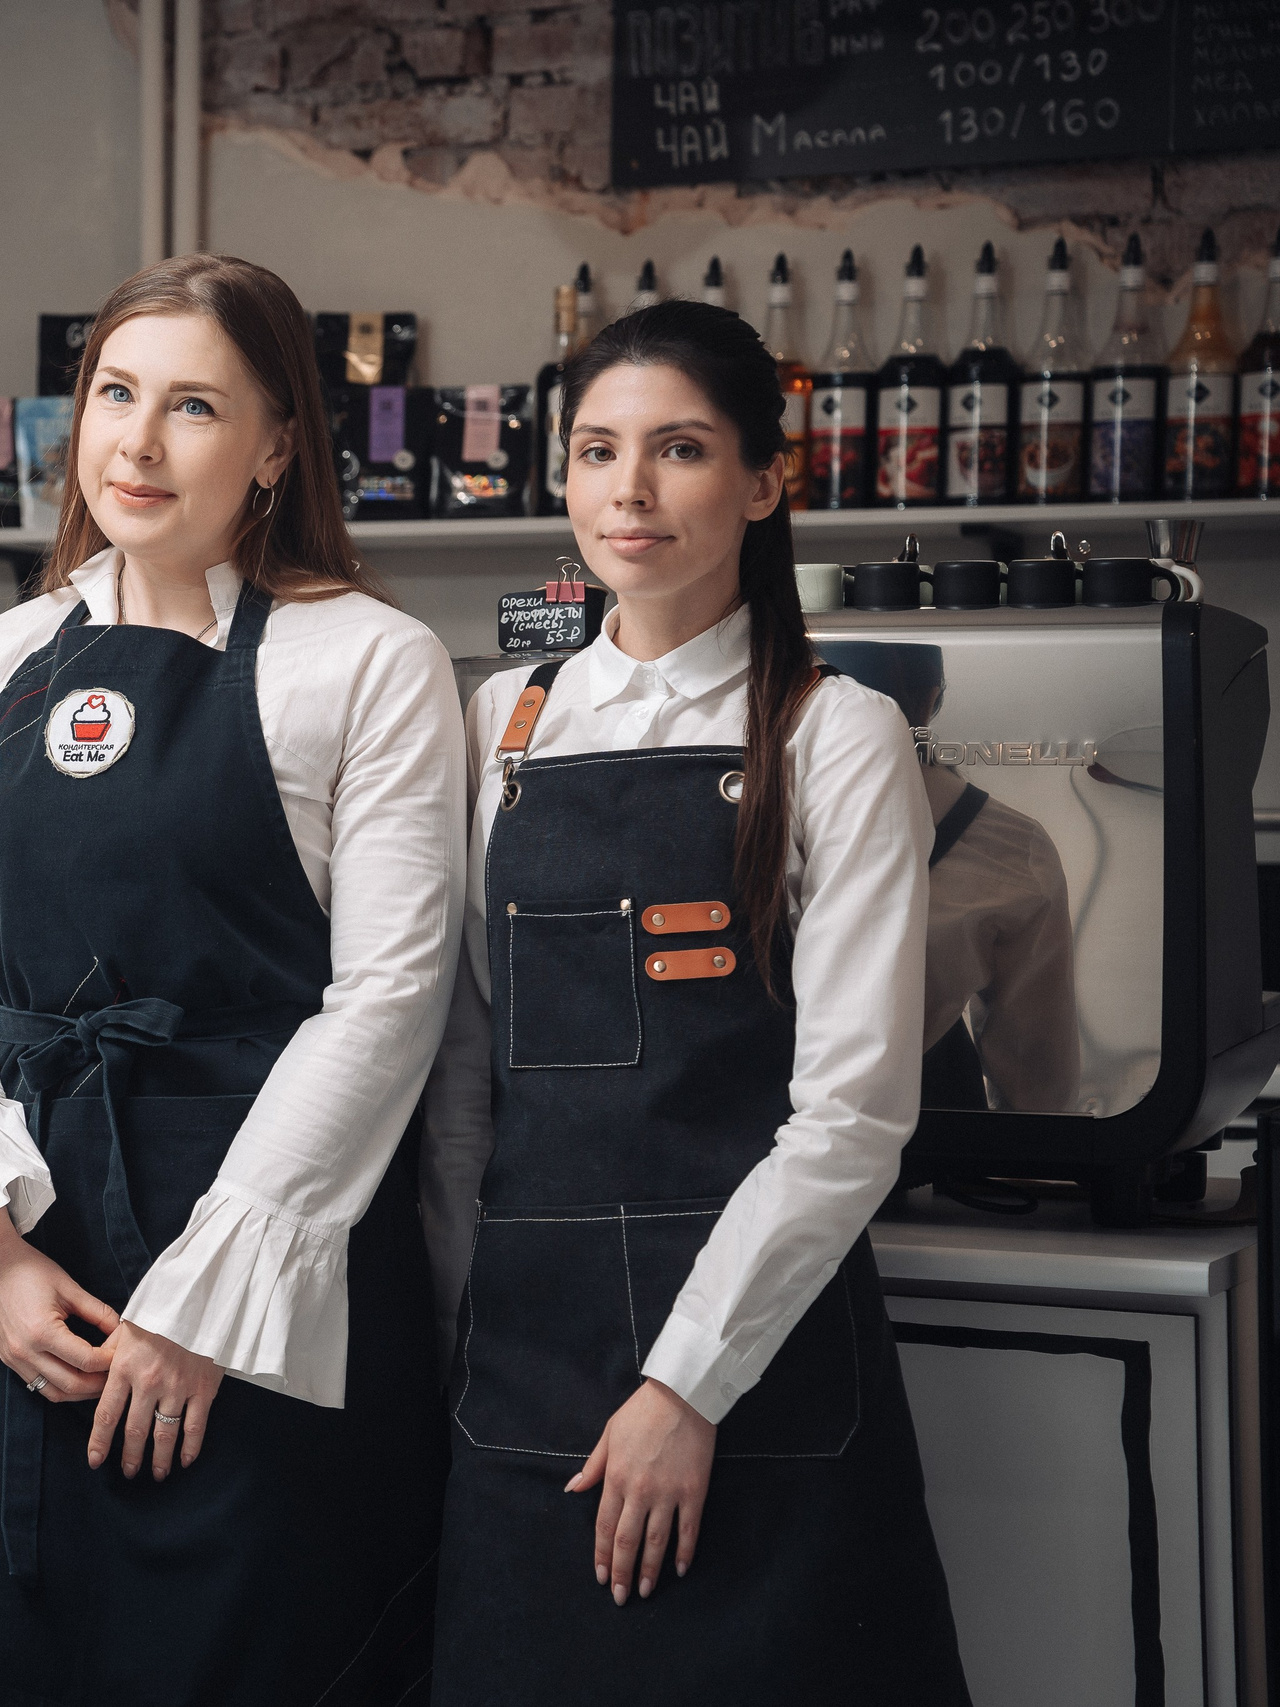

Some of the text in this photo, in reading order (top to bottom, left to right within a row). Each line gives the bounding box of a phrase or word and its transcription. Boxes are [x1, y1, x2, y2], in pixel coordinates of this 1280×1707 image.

[915, 7, 997, 53] 200
[1006, 0, 1075, 46] 250
[653, 75, 721, 118] ЧАЙ
[655, 117, 730, 169] ЧАЙ
[62, 750, 106, 762] Eat Me
